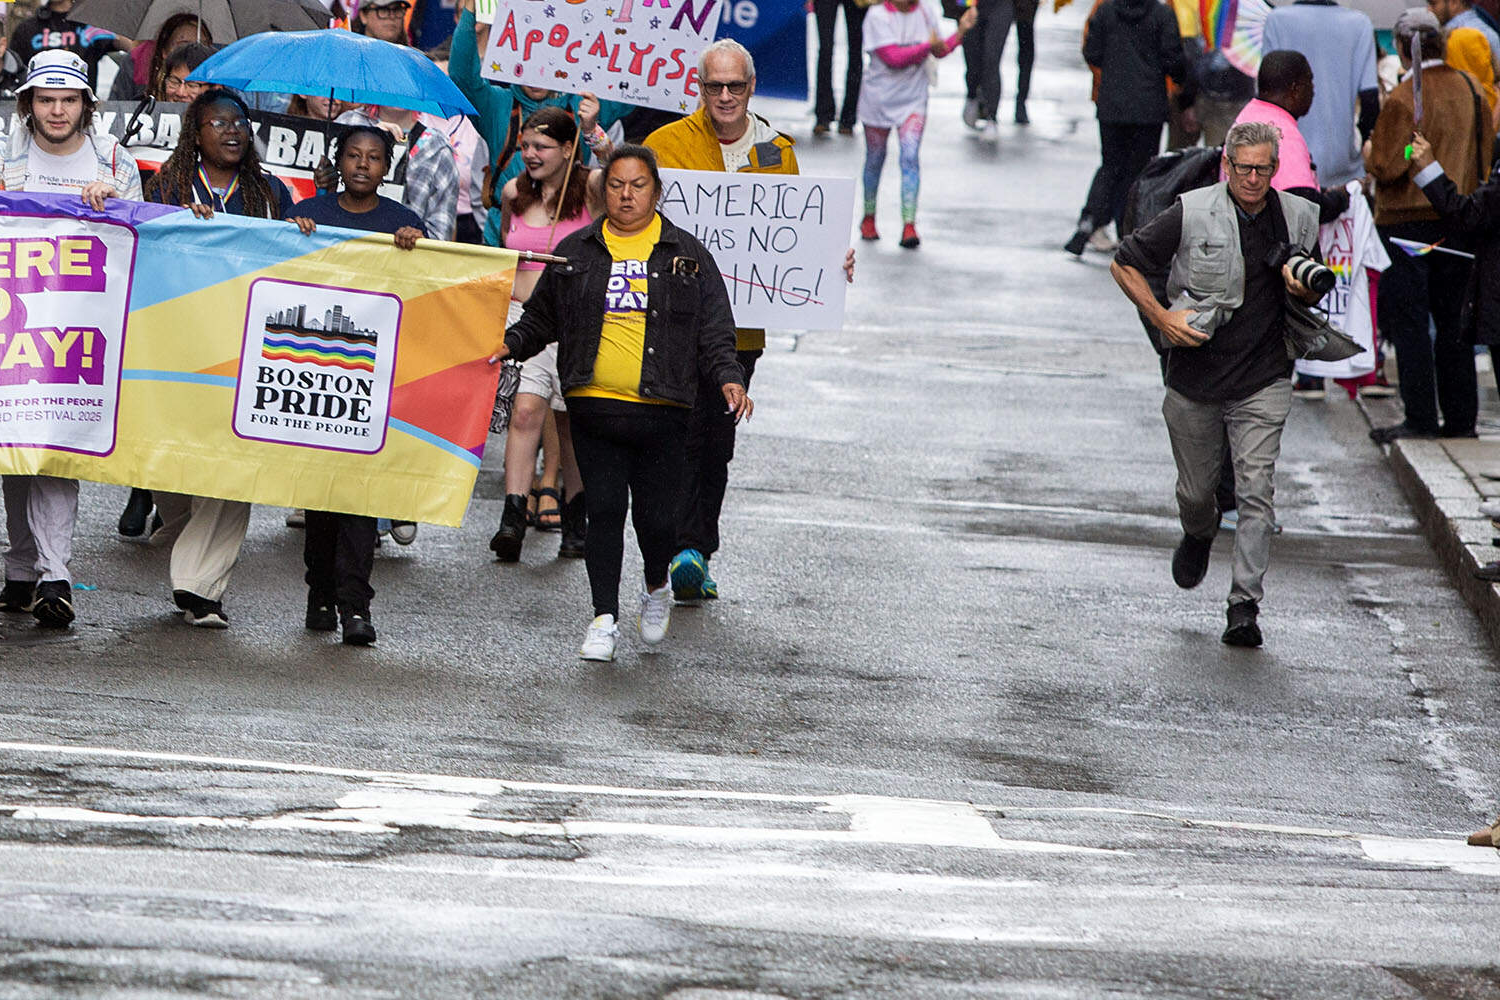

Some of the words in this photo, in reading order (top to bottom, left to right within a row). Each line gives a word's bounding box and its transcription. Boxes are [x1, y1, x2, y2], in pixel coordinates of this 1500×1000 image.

[496, 9, 699, 97] APOCALYPSE
[663, 181, 825, 224] AMERICA
[694, 224, 736, 251] HAS
[748, 226, 798, 253] NO
[732, 264, 825, 306] ING!
[256, 366, 374, 396] BOSTON
[15, 398, 40, 407] FOR
[42, 397, 65, 406] THE
[66, 397, 104, 408] PEOPLE
[16, 410, 78, 423] FESTIVAL
[78, 411, 102, 423] 2025
[253, 386, 371, 423] PRIDE
[250, 413, 279, 426] FOR
[284, 418, 312, 430] THE
[315, 422, 371, 437] PEOPLE
